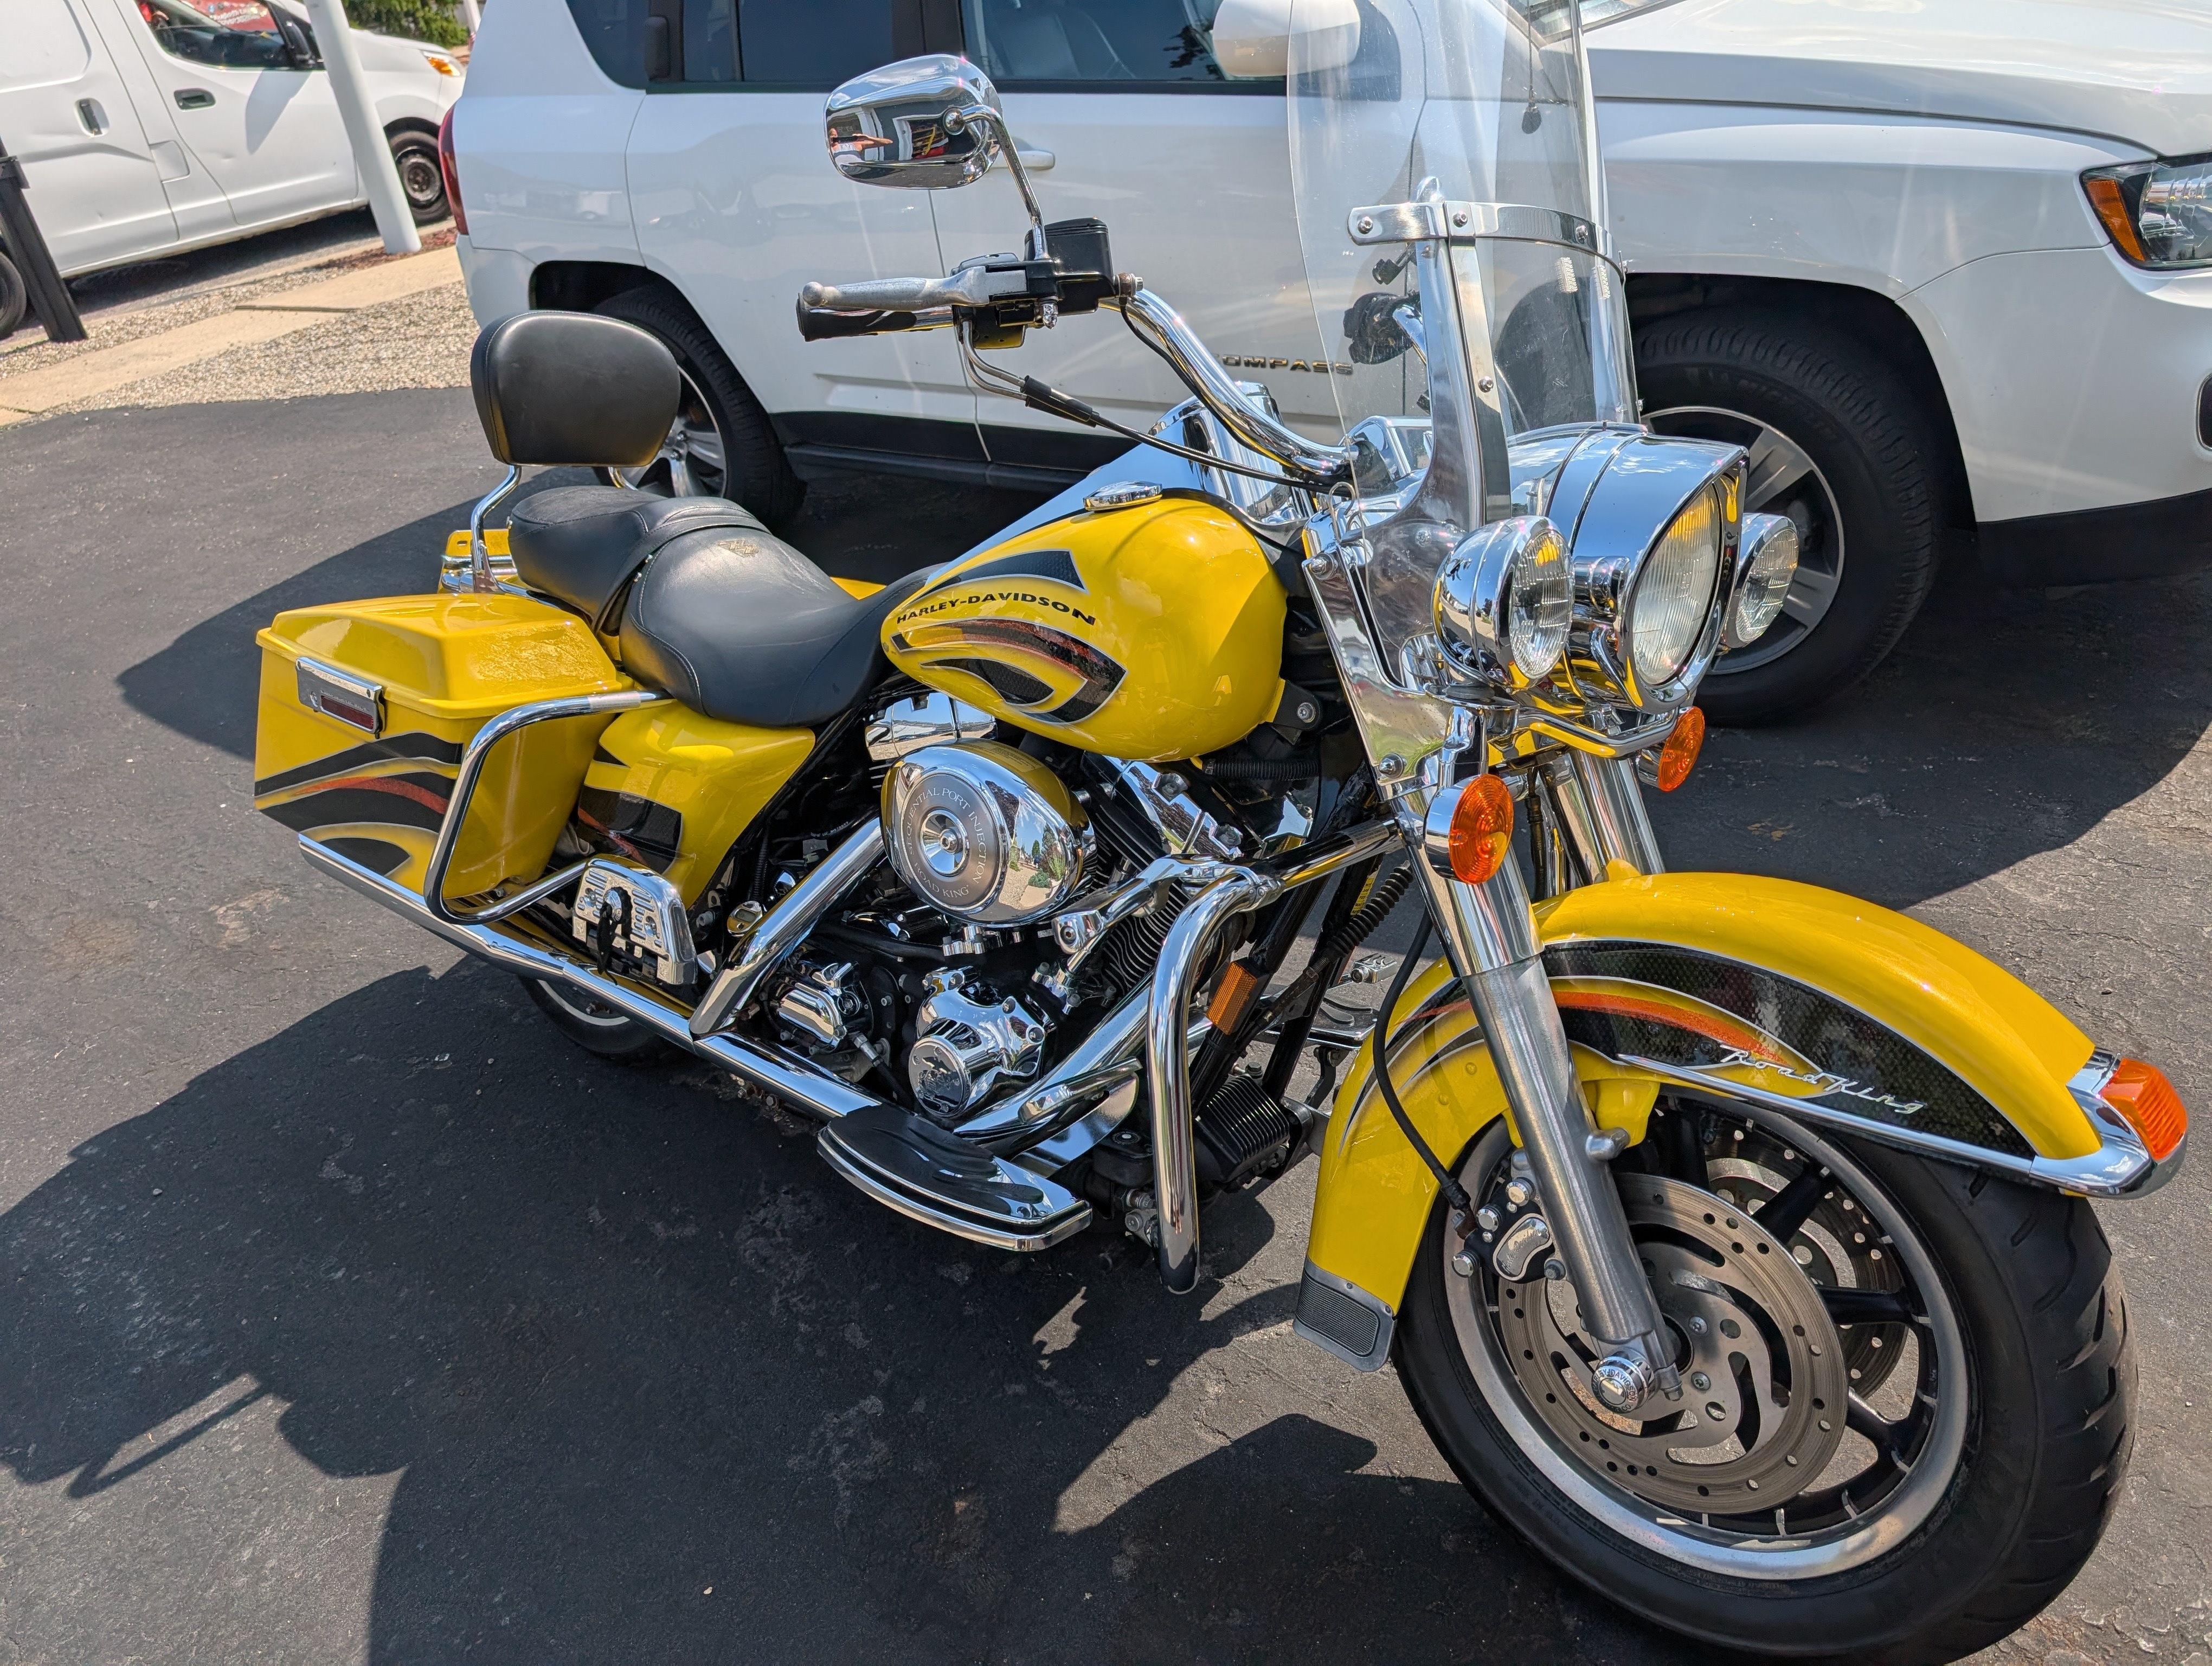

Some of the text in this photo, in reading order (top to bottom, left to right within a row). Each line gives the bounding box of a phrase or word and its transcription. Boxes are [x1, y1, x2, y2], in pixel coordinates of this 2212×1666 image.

[1216, 354, 1353, 375] OMPASS
[897, 592, 1096, 626] HARLEY-DAVIDSON
[906, 787, 987, 884] SEQUENTIAL PORT INJECTION
[914, 862, 969, 898] ROAD KING
[1720, 1044, 1928, 1114] Road King
